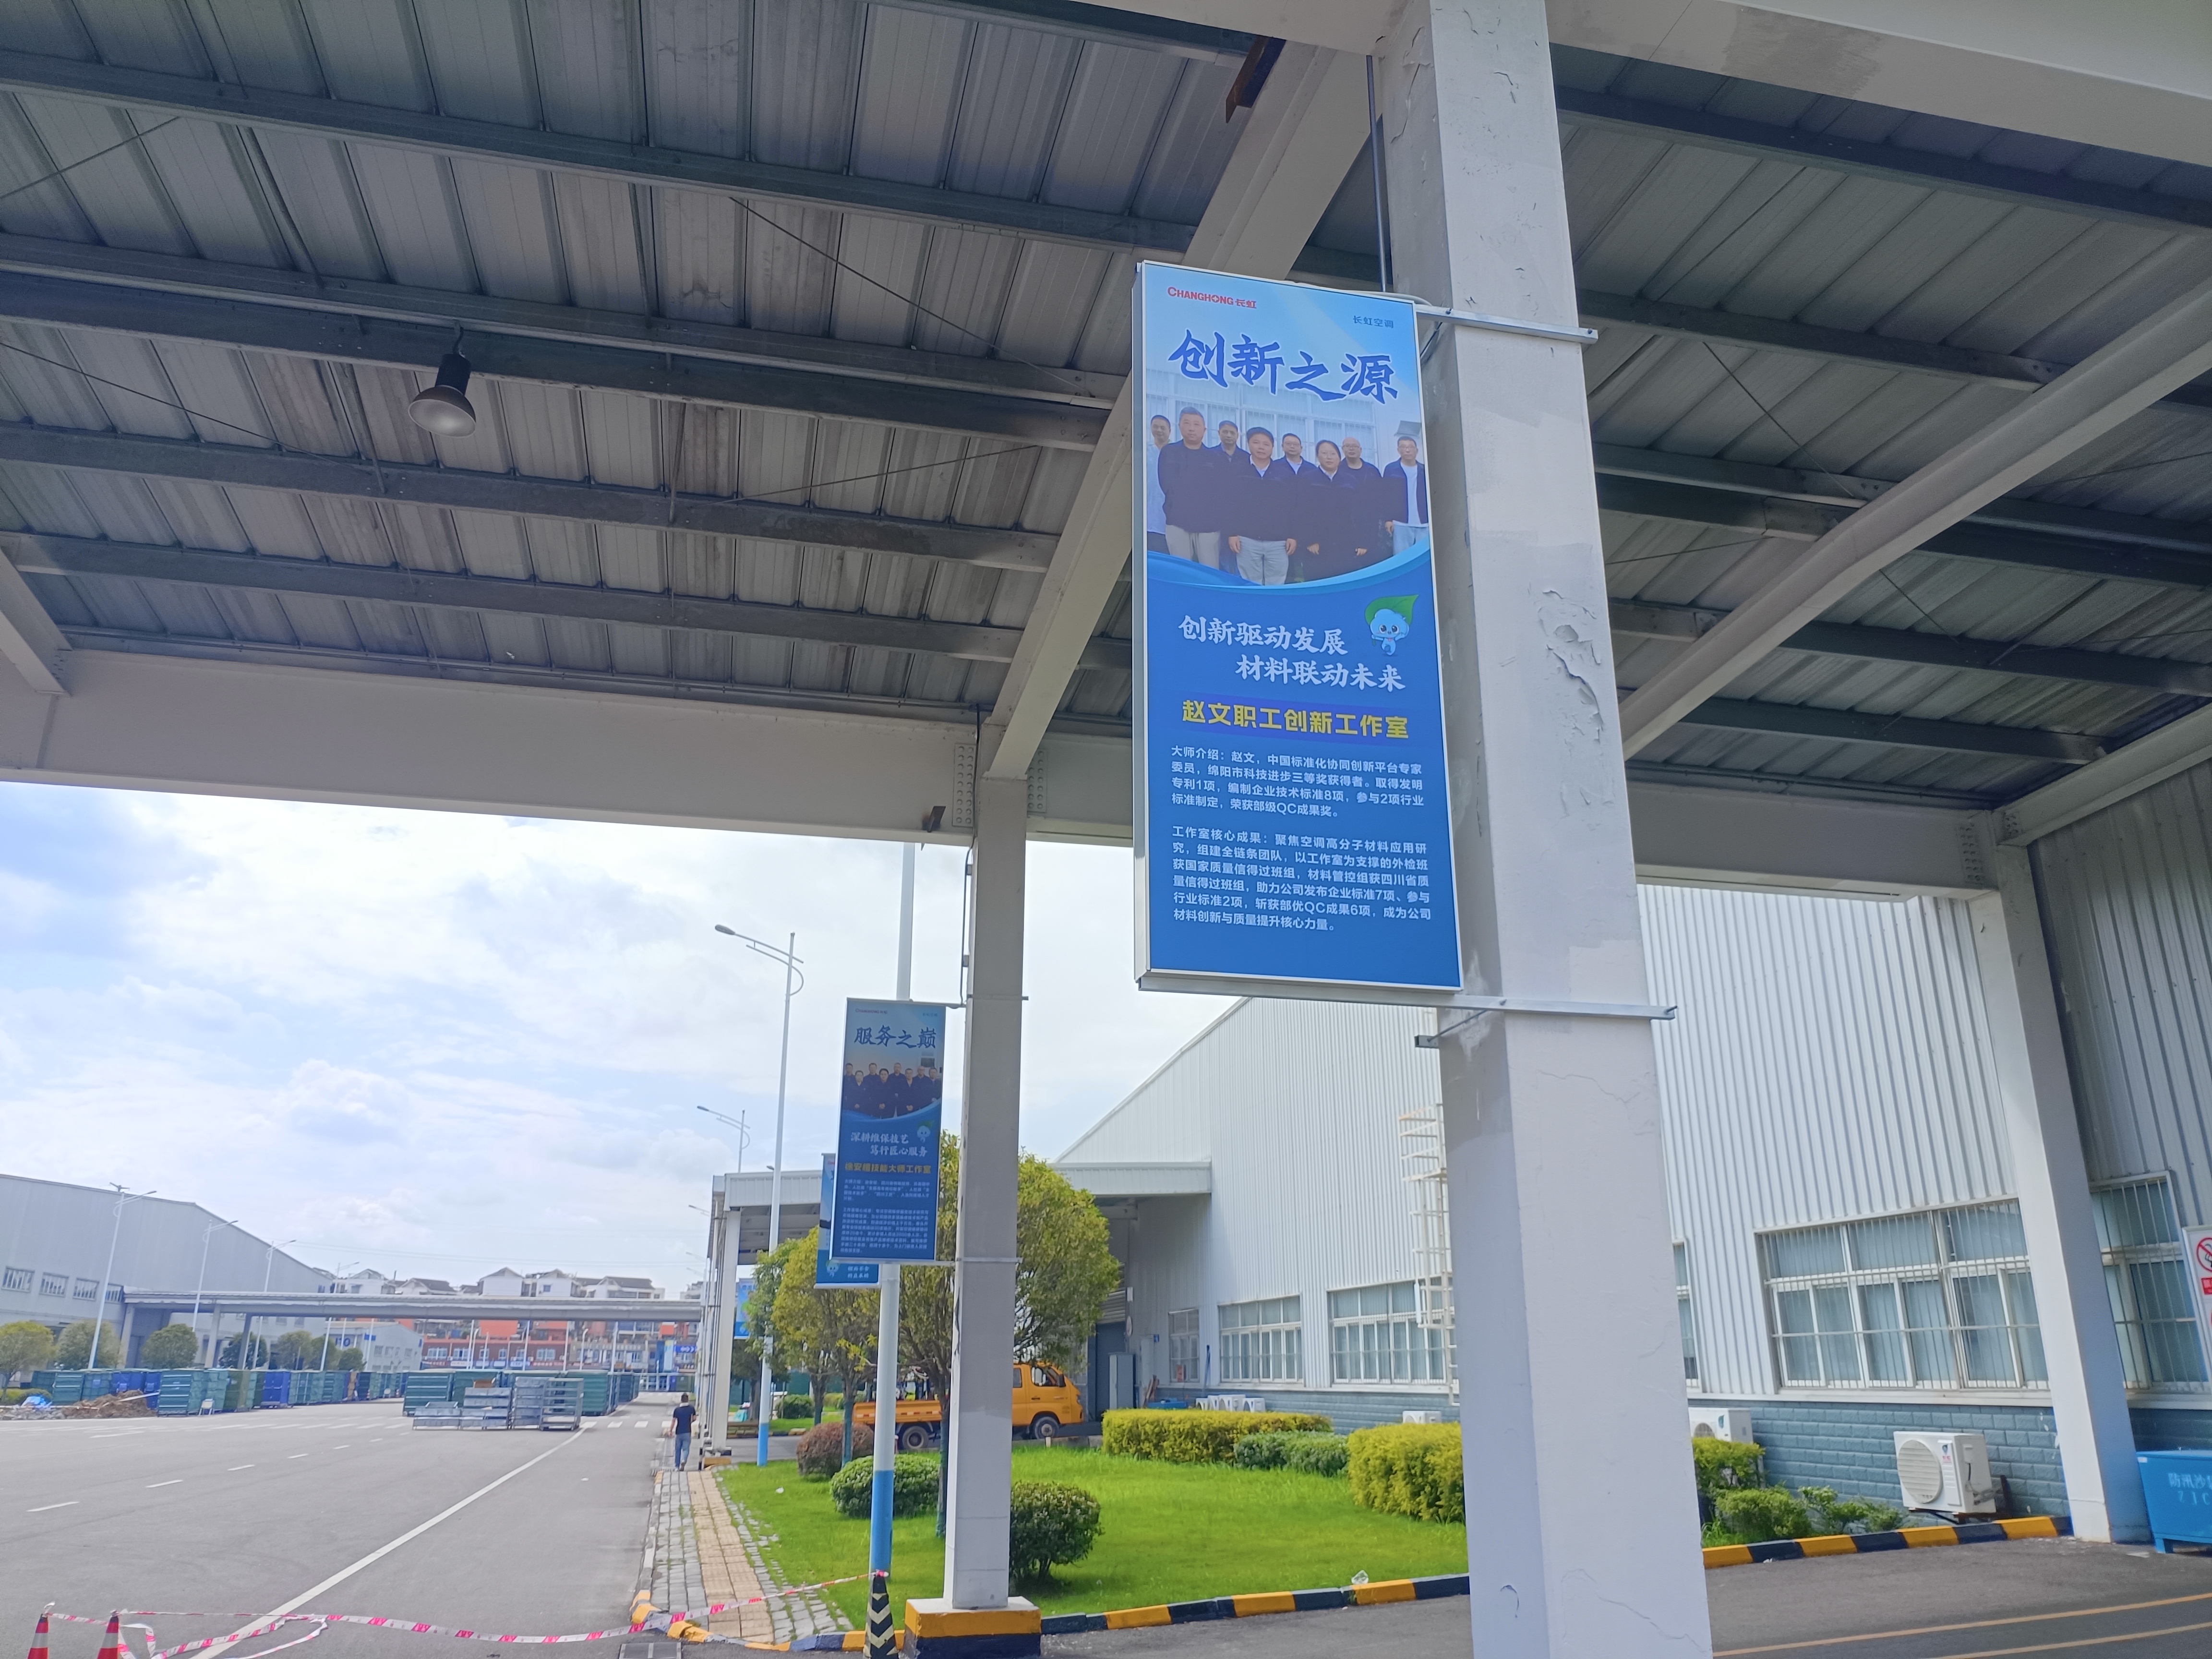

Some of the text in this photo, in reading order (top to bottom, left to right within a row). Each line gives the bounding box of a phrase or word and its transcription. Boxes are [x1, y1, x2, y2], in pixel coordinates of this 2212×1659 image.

[1167, 287, 1257, 309] CHANGHONG 长虹
[1352, 315, 1394, 329] 长虹空调
[1168, 329, 1398, 404] 创新之源
[1178, 615, 1348, 655] 创新驱动发展
[1235, 654, 1406, 692] 材料联动未来
[1182, 699, 1409, 739] 赵文职工创新工作室
[854, 1024, 936, 1049] 服务之巅
